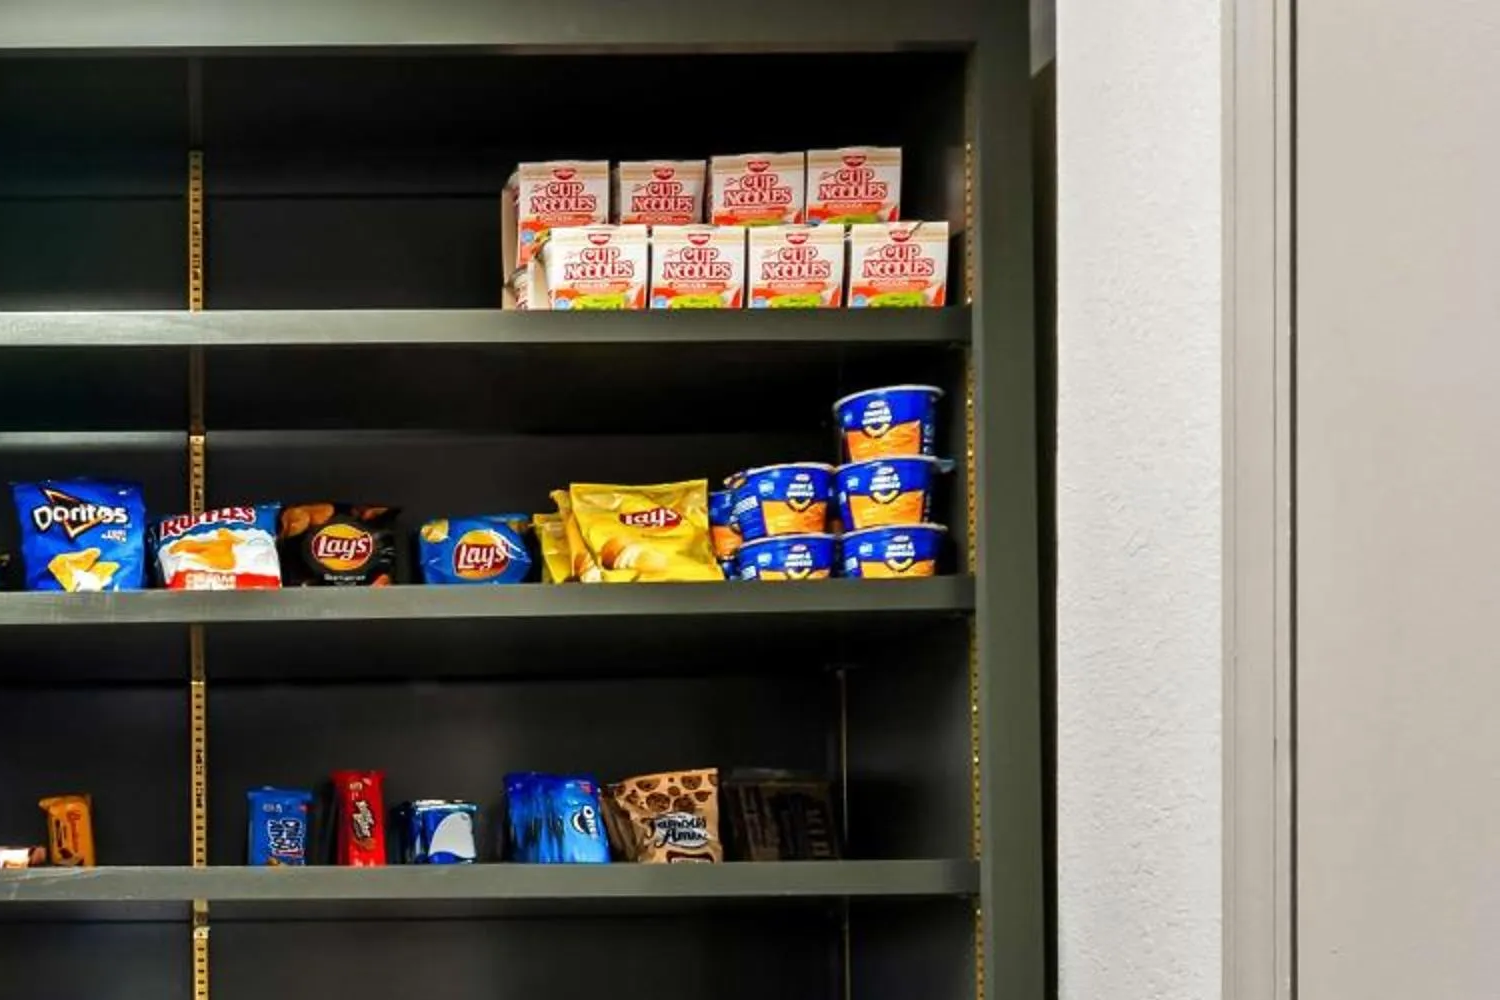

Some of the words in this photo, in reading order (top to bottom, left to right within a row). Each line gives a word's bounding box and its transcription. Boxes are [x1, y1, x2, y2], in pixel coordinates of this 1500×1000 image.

[740, 174, 778, 189] CUP
[835, 169, 874, 185] CUP
[547, 182, 584, 197] CUP
[649, 182, 683, 197] CUP
[724, 188, 792, 207] NOODLES
[818, 182, 888, 200] NOODLES
[531, 195, 596, 213] NOODLES
[632, 196, 695, 212] NOODLES
[580, 248, 621, 264] CUP
[680, 248, 719, 263] CUP
[778, 246, 818, 262] CUP
[880, 245, 921, 261] CUP
[564, 260, 635, 280] NOODLES
[663, 262, 732, 280] NOODLES
[762, 259, 831, 280] NOODLES
[863, 258, 935, 278] NOODLES
[33, 504, 129, 531] Doritos
